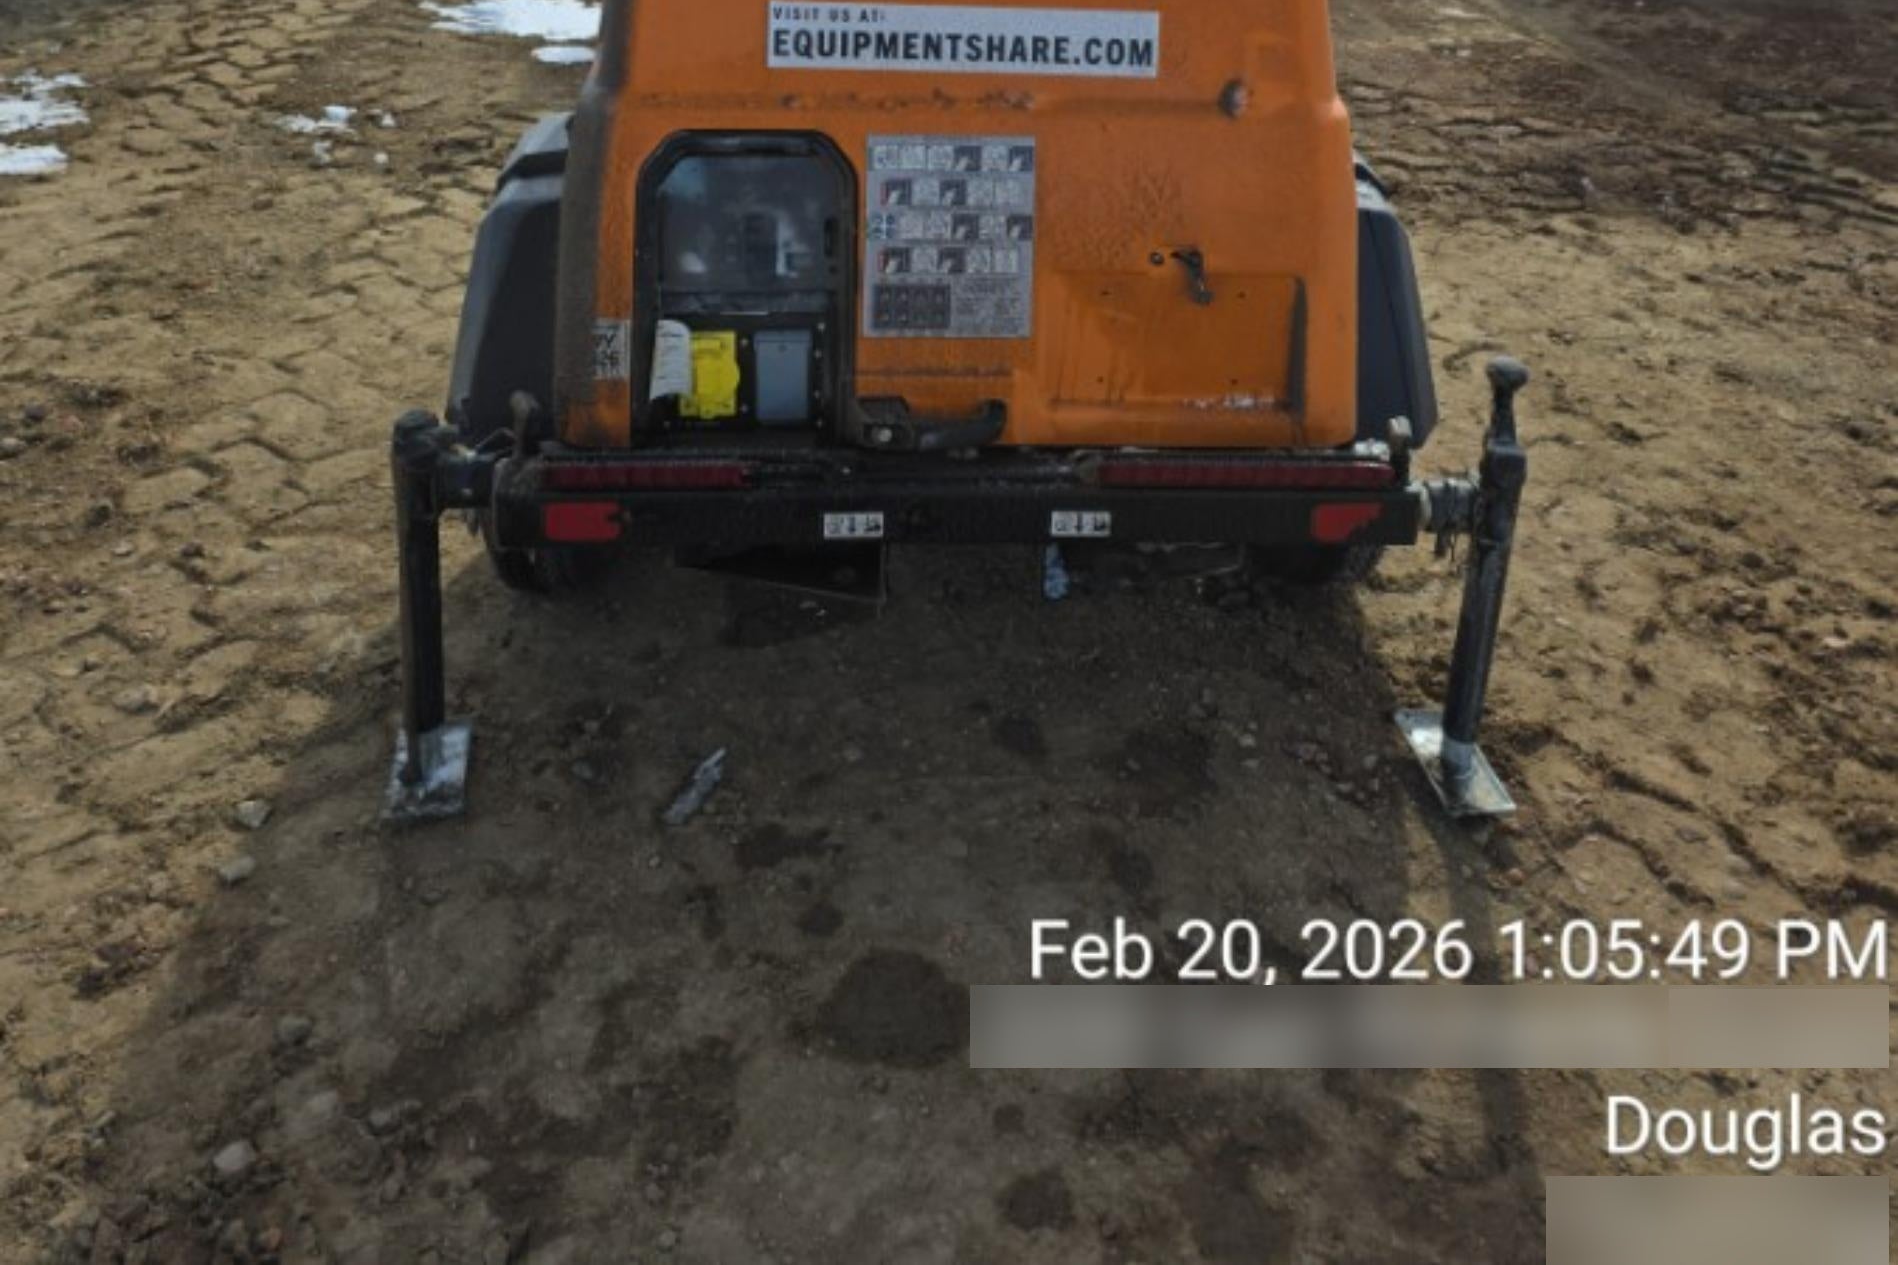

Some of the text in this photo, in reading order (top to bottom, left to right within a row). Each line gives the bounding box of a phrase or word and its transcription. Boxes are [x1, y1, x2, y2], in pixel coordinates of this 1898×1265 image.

[773, 7, 820, 21] VISIT
[829, 8, 851, 23] US
[773, 29, 1154, 67] EQUIPMENTSHARE.COM
